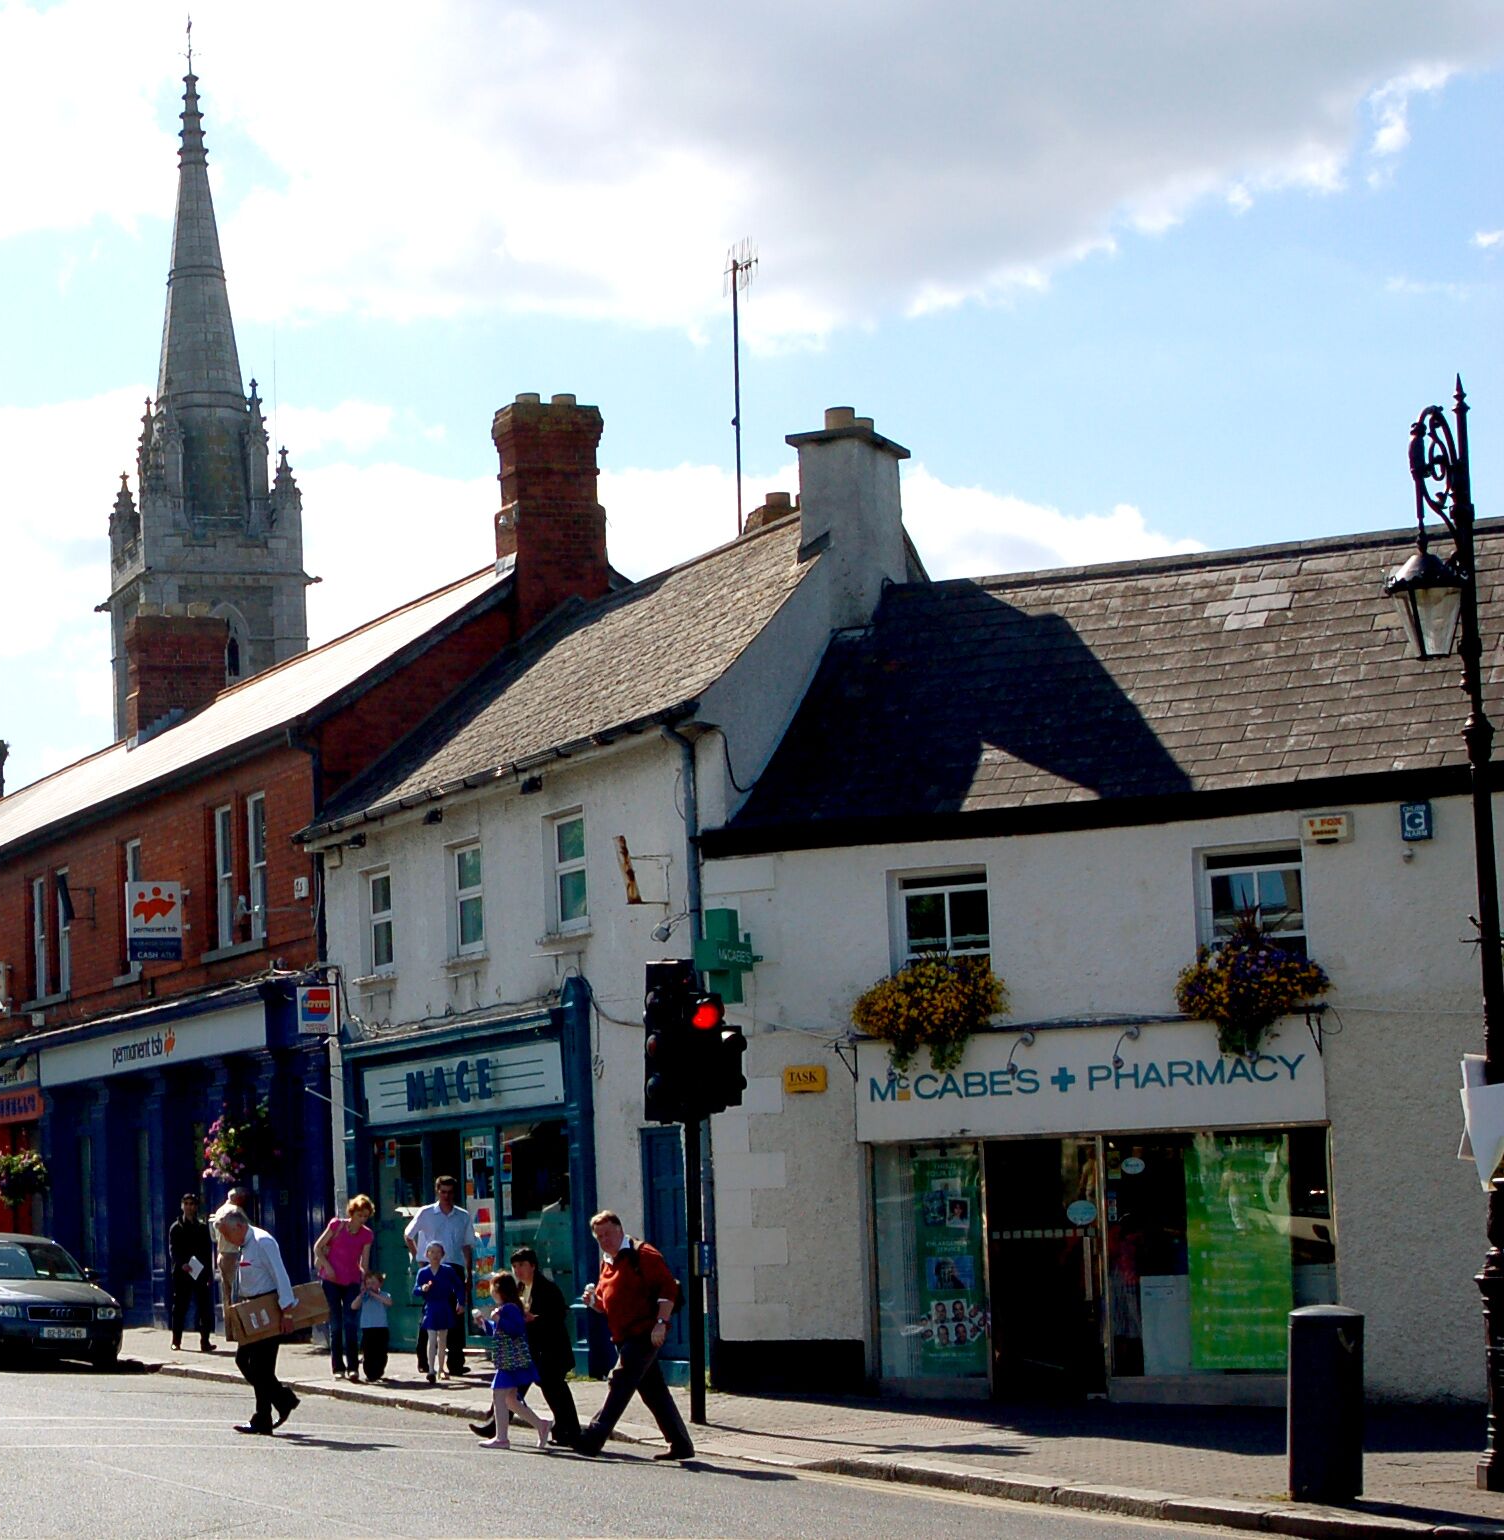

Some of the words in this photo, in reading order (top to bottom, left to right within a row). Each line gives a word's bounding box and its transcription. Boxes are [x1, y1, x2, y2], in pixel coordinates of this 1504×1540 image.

[1320, 817, 1343, 827] FOX
[1404, 829, 1428, 838] ALARM
[133, 926, 166, 934] permanent
[137, 951, 158, 959] CASH
[303, 999, 330, 1009] LOTTO
[112, 1036, 151, 1069] permanent
[151, 1031, 164, 1057] tsb
[788, 1071, 819, 1083] TASK
[1087, 1053, 1306, 1092] PHARMACY
[405, 1057, 493, 1112] MACE
